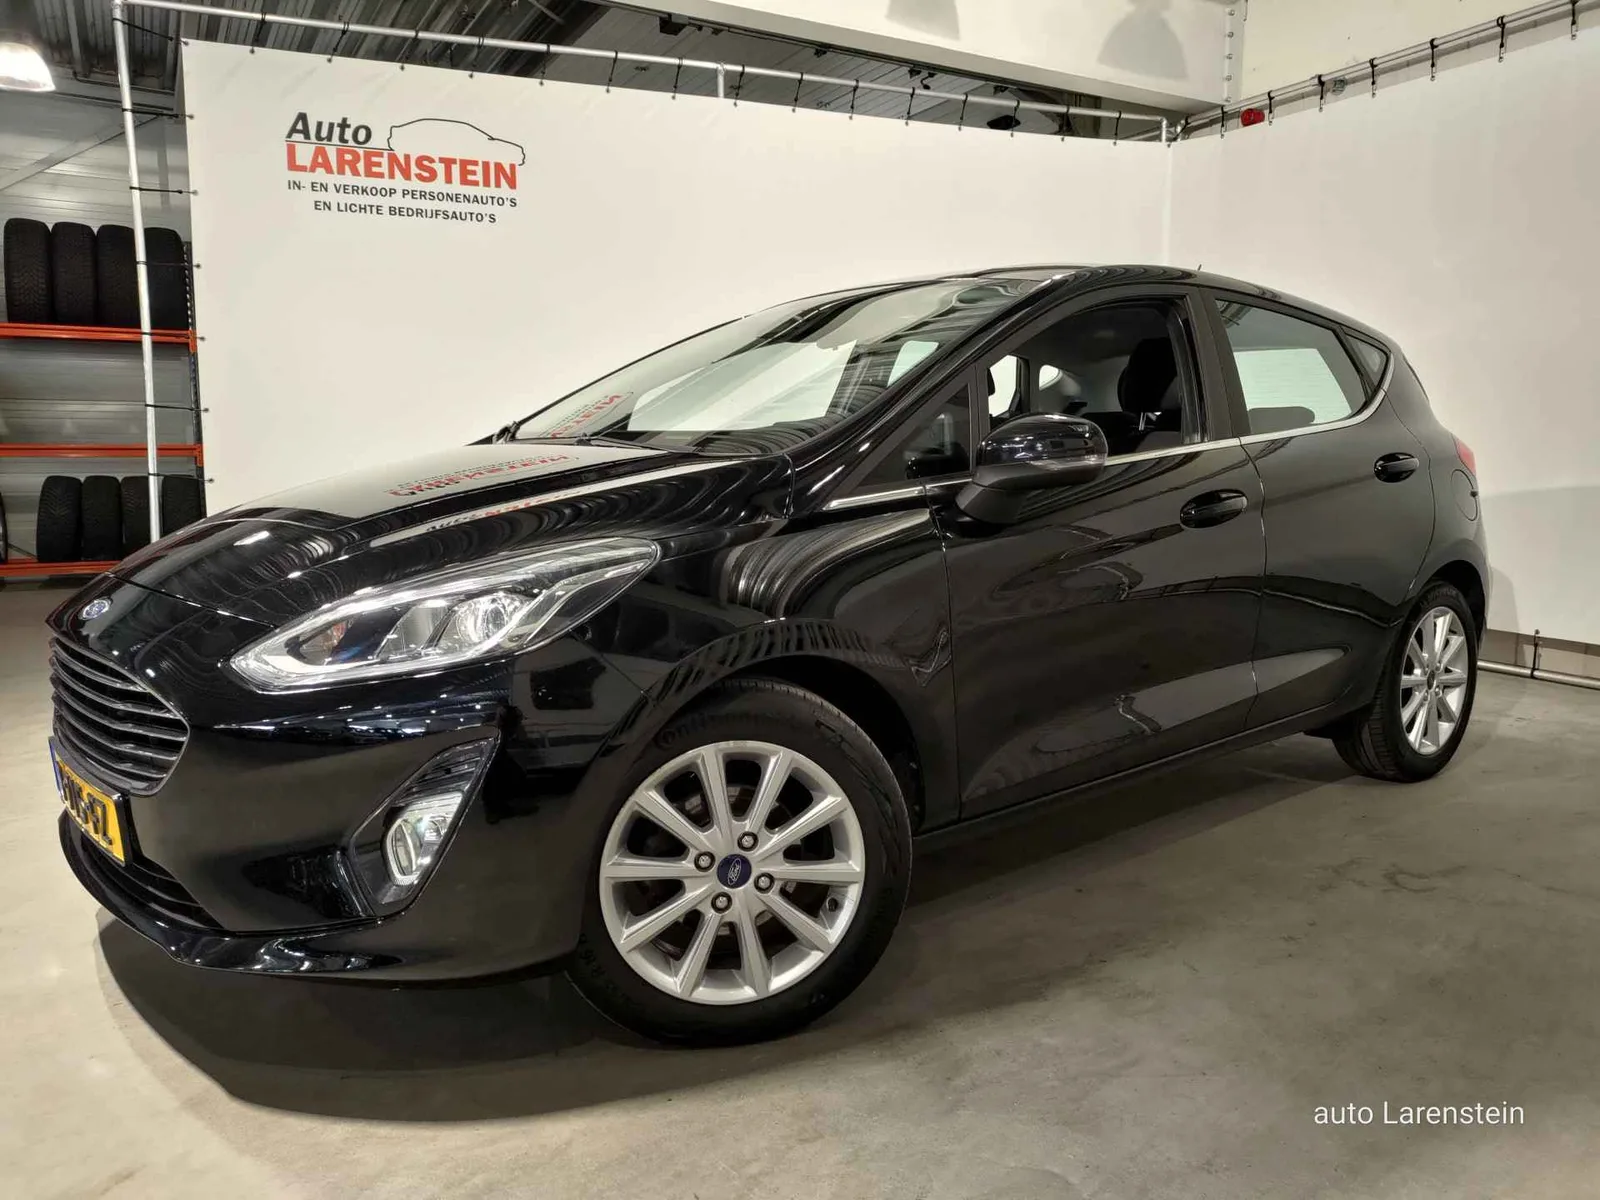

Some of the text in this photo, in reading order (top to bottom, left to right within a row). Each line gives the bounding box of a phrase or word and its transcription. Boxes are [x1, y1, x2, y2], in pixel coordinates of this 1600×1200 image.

[285, 111, 372, 146] Auto
[285, 143, 518, 190] LARENSTEIN
[287, 179, 518, 207] IN- EN VERKOOP PERSONENAUTO'S
[313, 200, 497, 223] EN LICHTE BEDRIJFSAUTO'S
